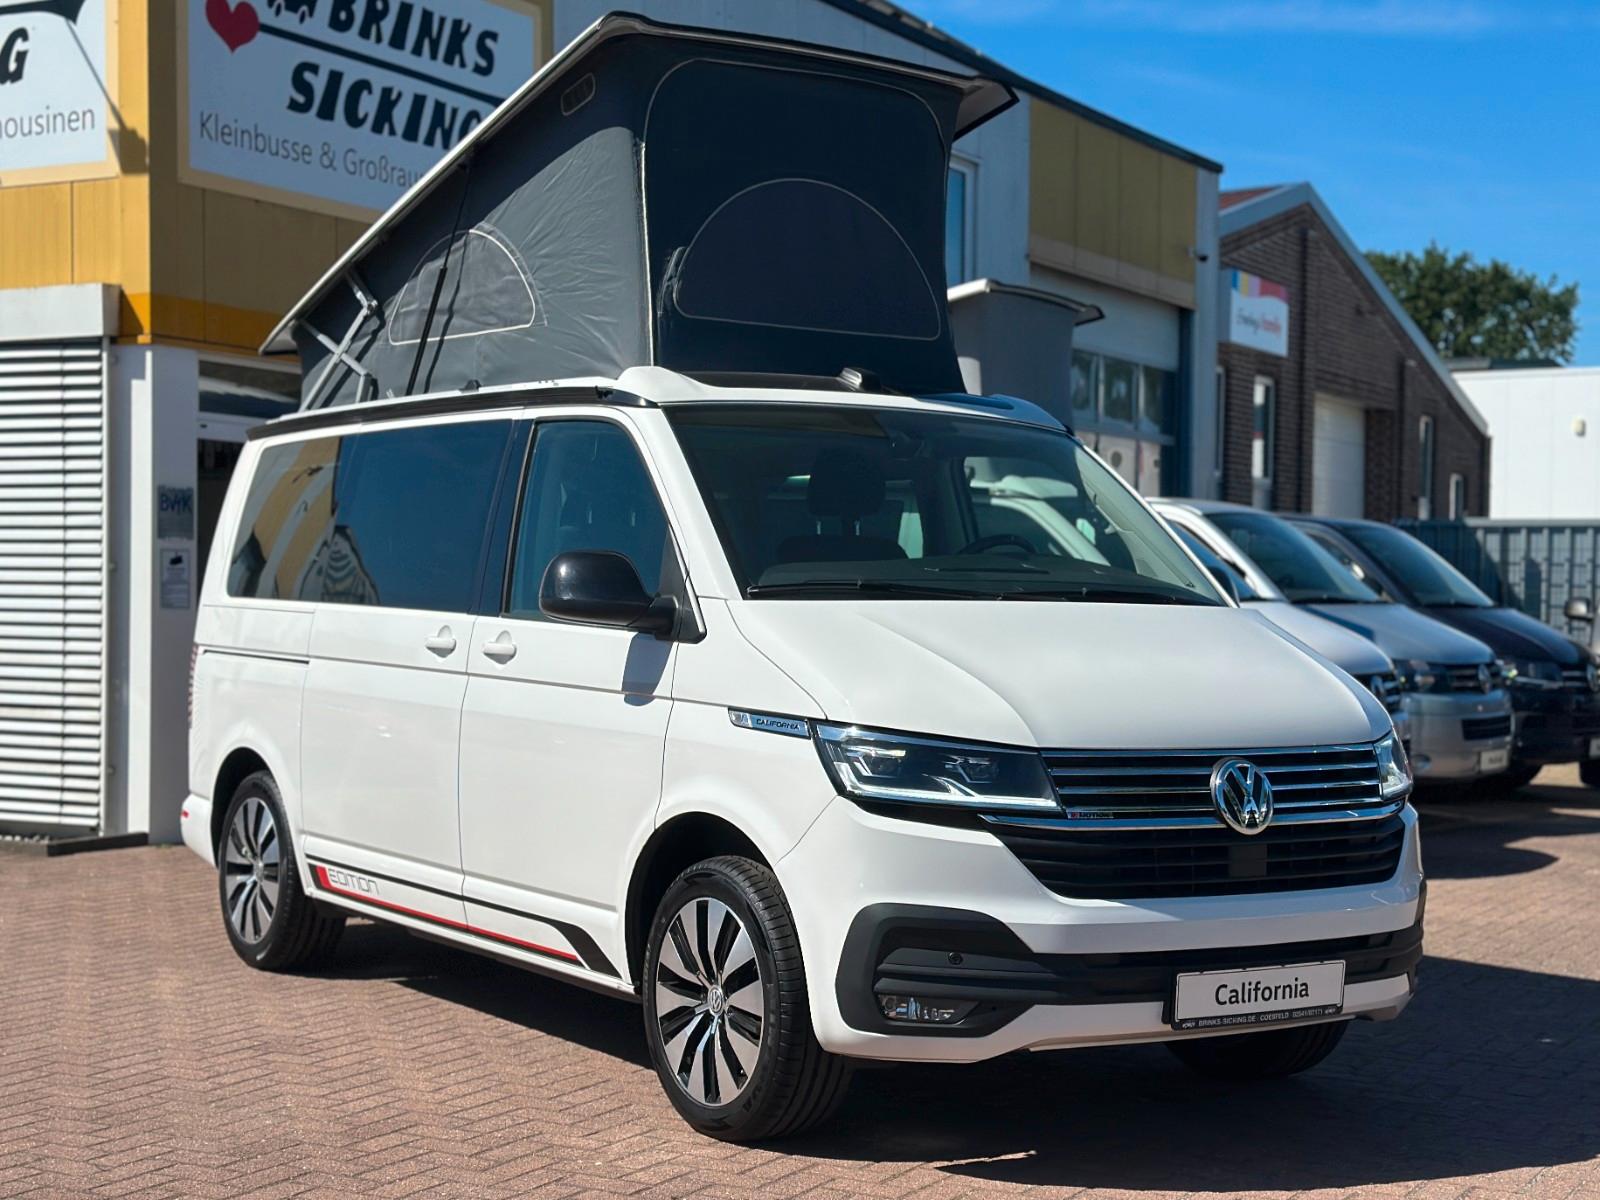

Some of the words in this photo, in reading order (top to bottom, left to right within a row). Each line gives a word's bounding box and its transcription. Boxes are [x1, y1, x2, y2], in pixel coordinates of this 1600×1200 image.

[328, 0, 498, 77] BRINKS
[0, 106, 95, 139] ousinen
[200, 111, 313, 165] Kleinbusse
[320, 141, 337, 173] &
[343, 147, 423, 190] Großrau
[756, 717, 800, 730] CALIFORNIA
[328, 868, 379, 896] EDITION
[1215, 977, 1309, 1006] California
